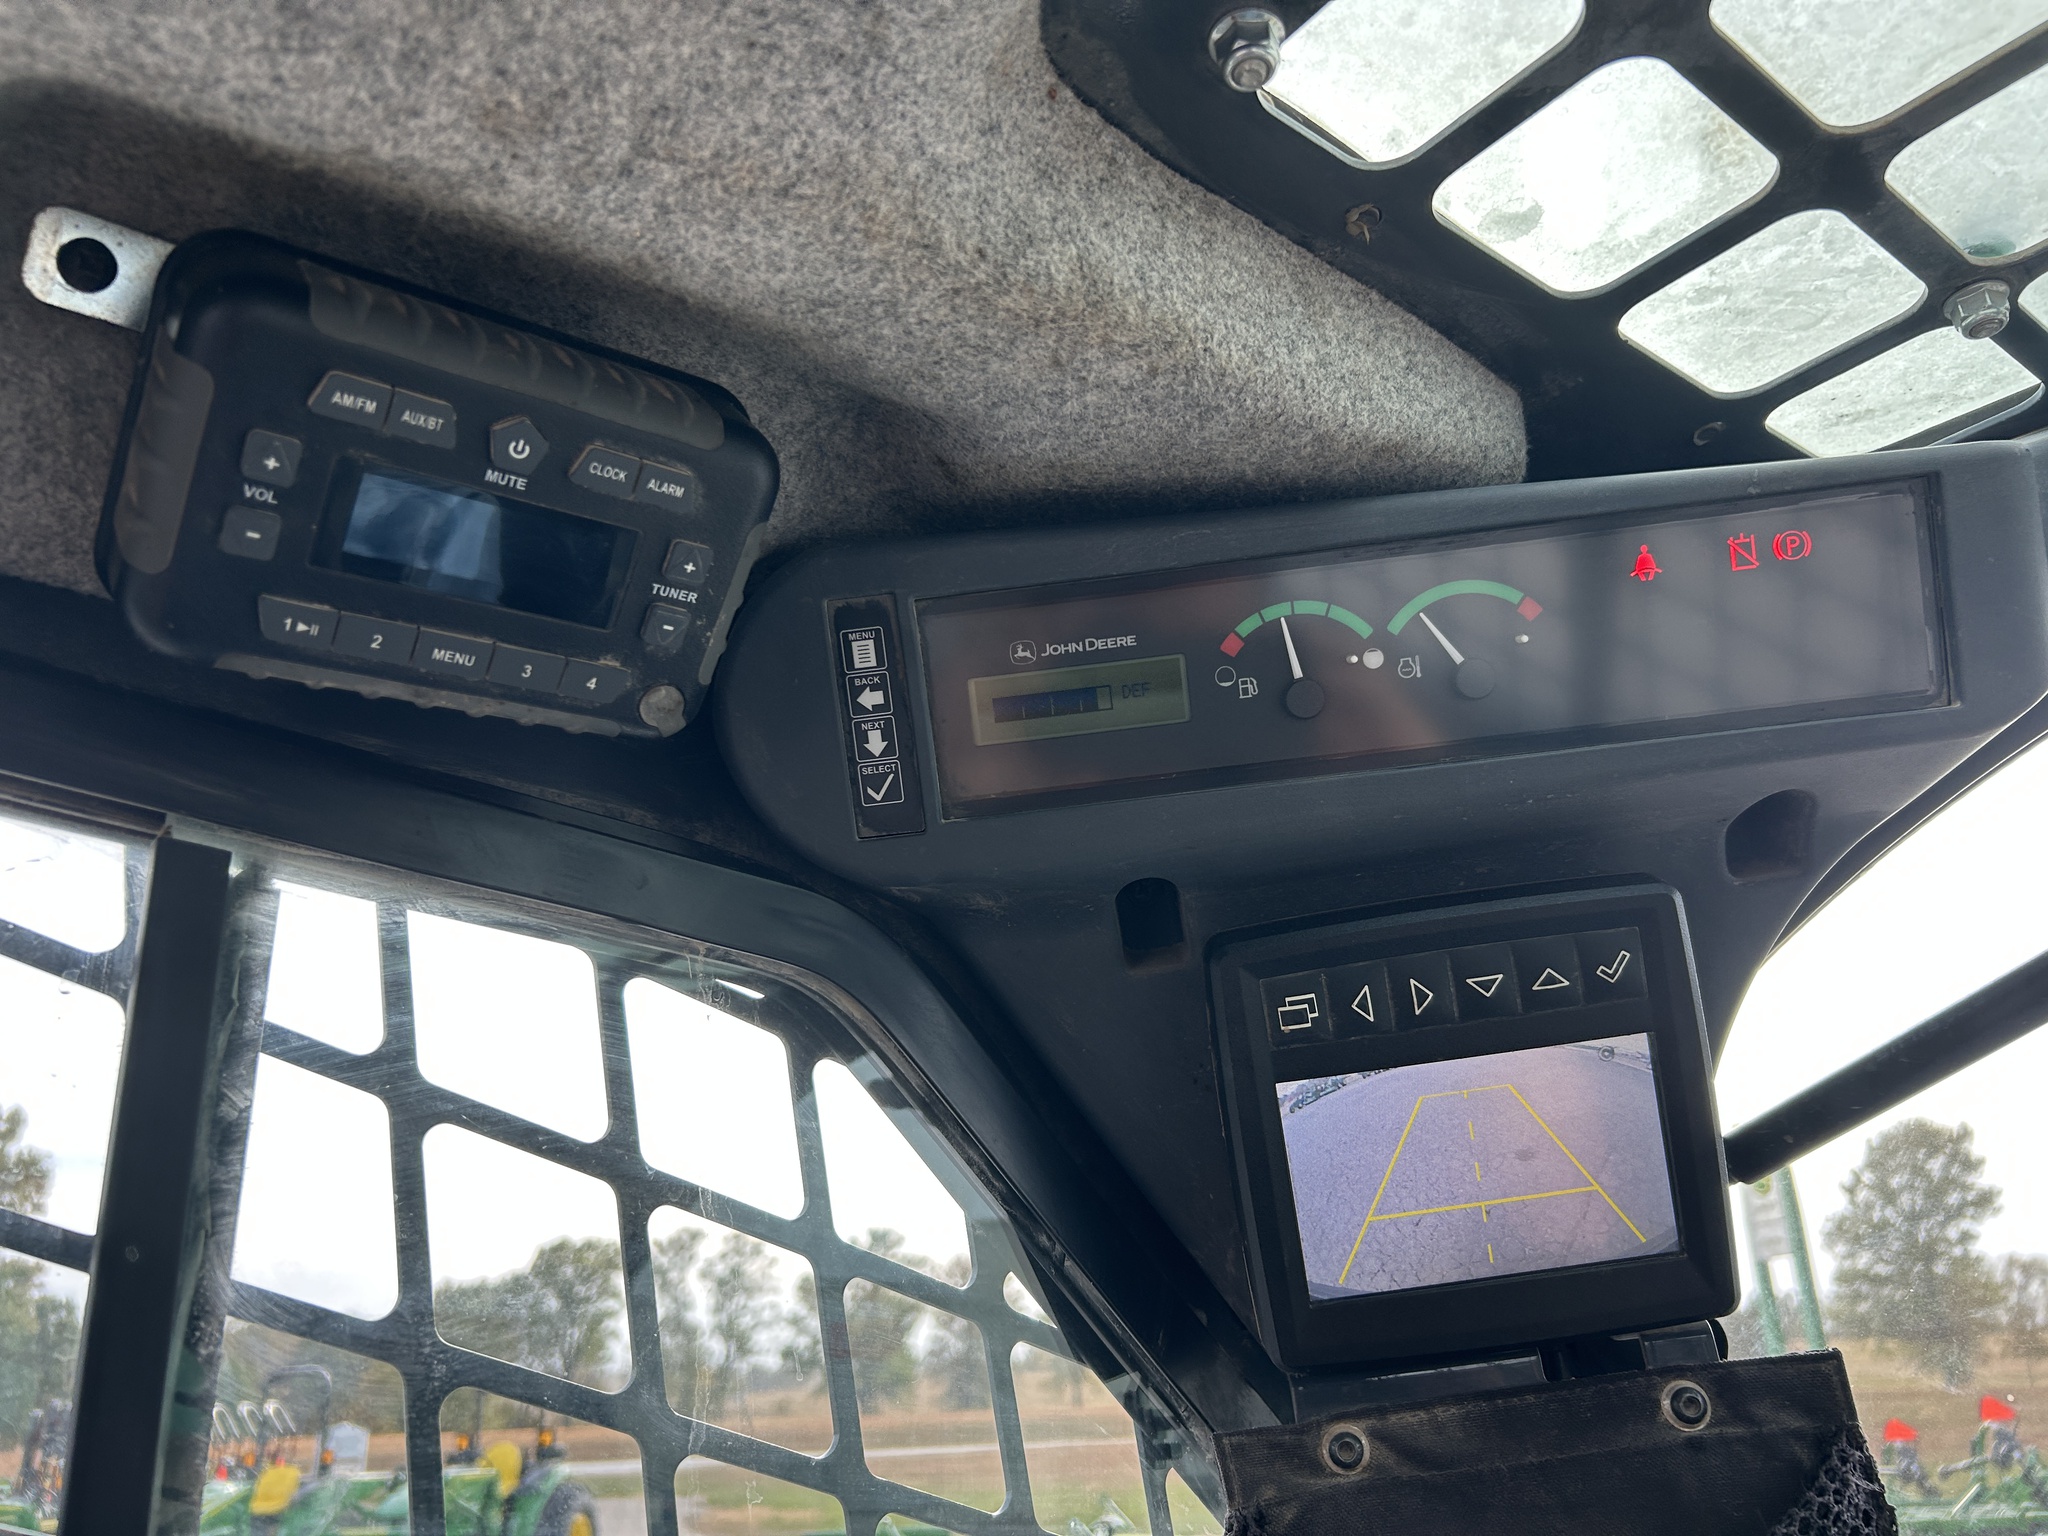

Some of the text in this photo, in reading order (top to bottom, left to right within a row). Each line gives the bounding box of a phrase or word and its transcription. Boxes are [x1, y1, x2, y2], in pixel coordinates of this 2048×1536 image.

[332, 391, 377, 414] AM/FM
[484, 469, 528, 491] MUTE
[588, 462, 628, 482] CLOCK
[243, 484, 278, 504] VOL
[646, 479, 685, 498] ALARM
[652, 583, 698, 603] TUNER
[284, 617, 293, 632] 1
[370, 634, 384, 649] 2
[848, 631, 876, 641] MENU
[1041, 635, 1137, 657] JOHN DEERE
[431, 648, 476, 667] MENU
[521, 664, 533, 678] 3
[586, 677, 598, 690] 4
[854, 676, 881, 686] BACK
[1121, 682, 1151, 699] DEF
[861, 720, 885, 731] NEXT
[861, 764, 896, 775] SELECT
